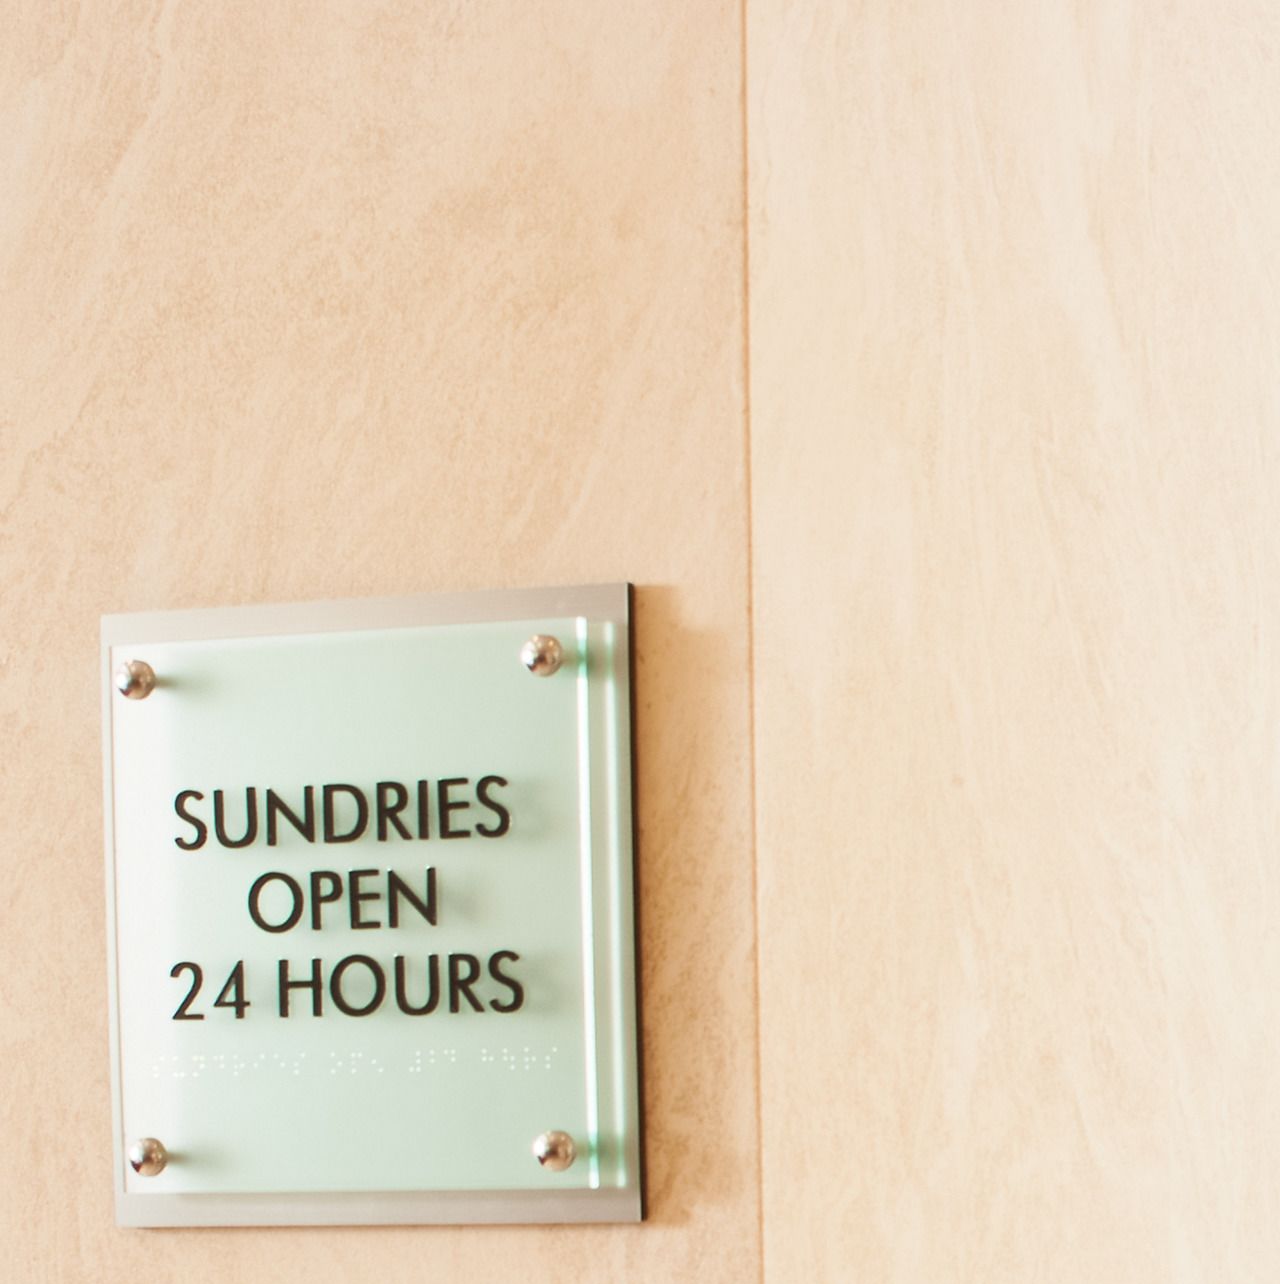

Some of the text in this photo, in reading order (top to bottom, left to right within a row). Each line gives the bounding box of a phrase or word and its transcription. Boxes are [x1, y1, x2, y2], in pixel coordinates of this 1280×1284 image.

[174, 775, 512, 850] SUNDRIES
[247, 866, 438, 934] OPEN
[169, 950, 525, 1021] 24 HOURS
